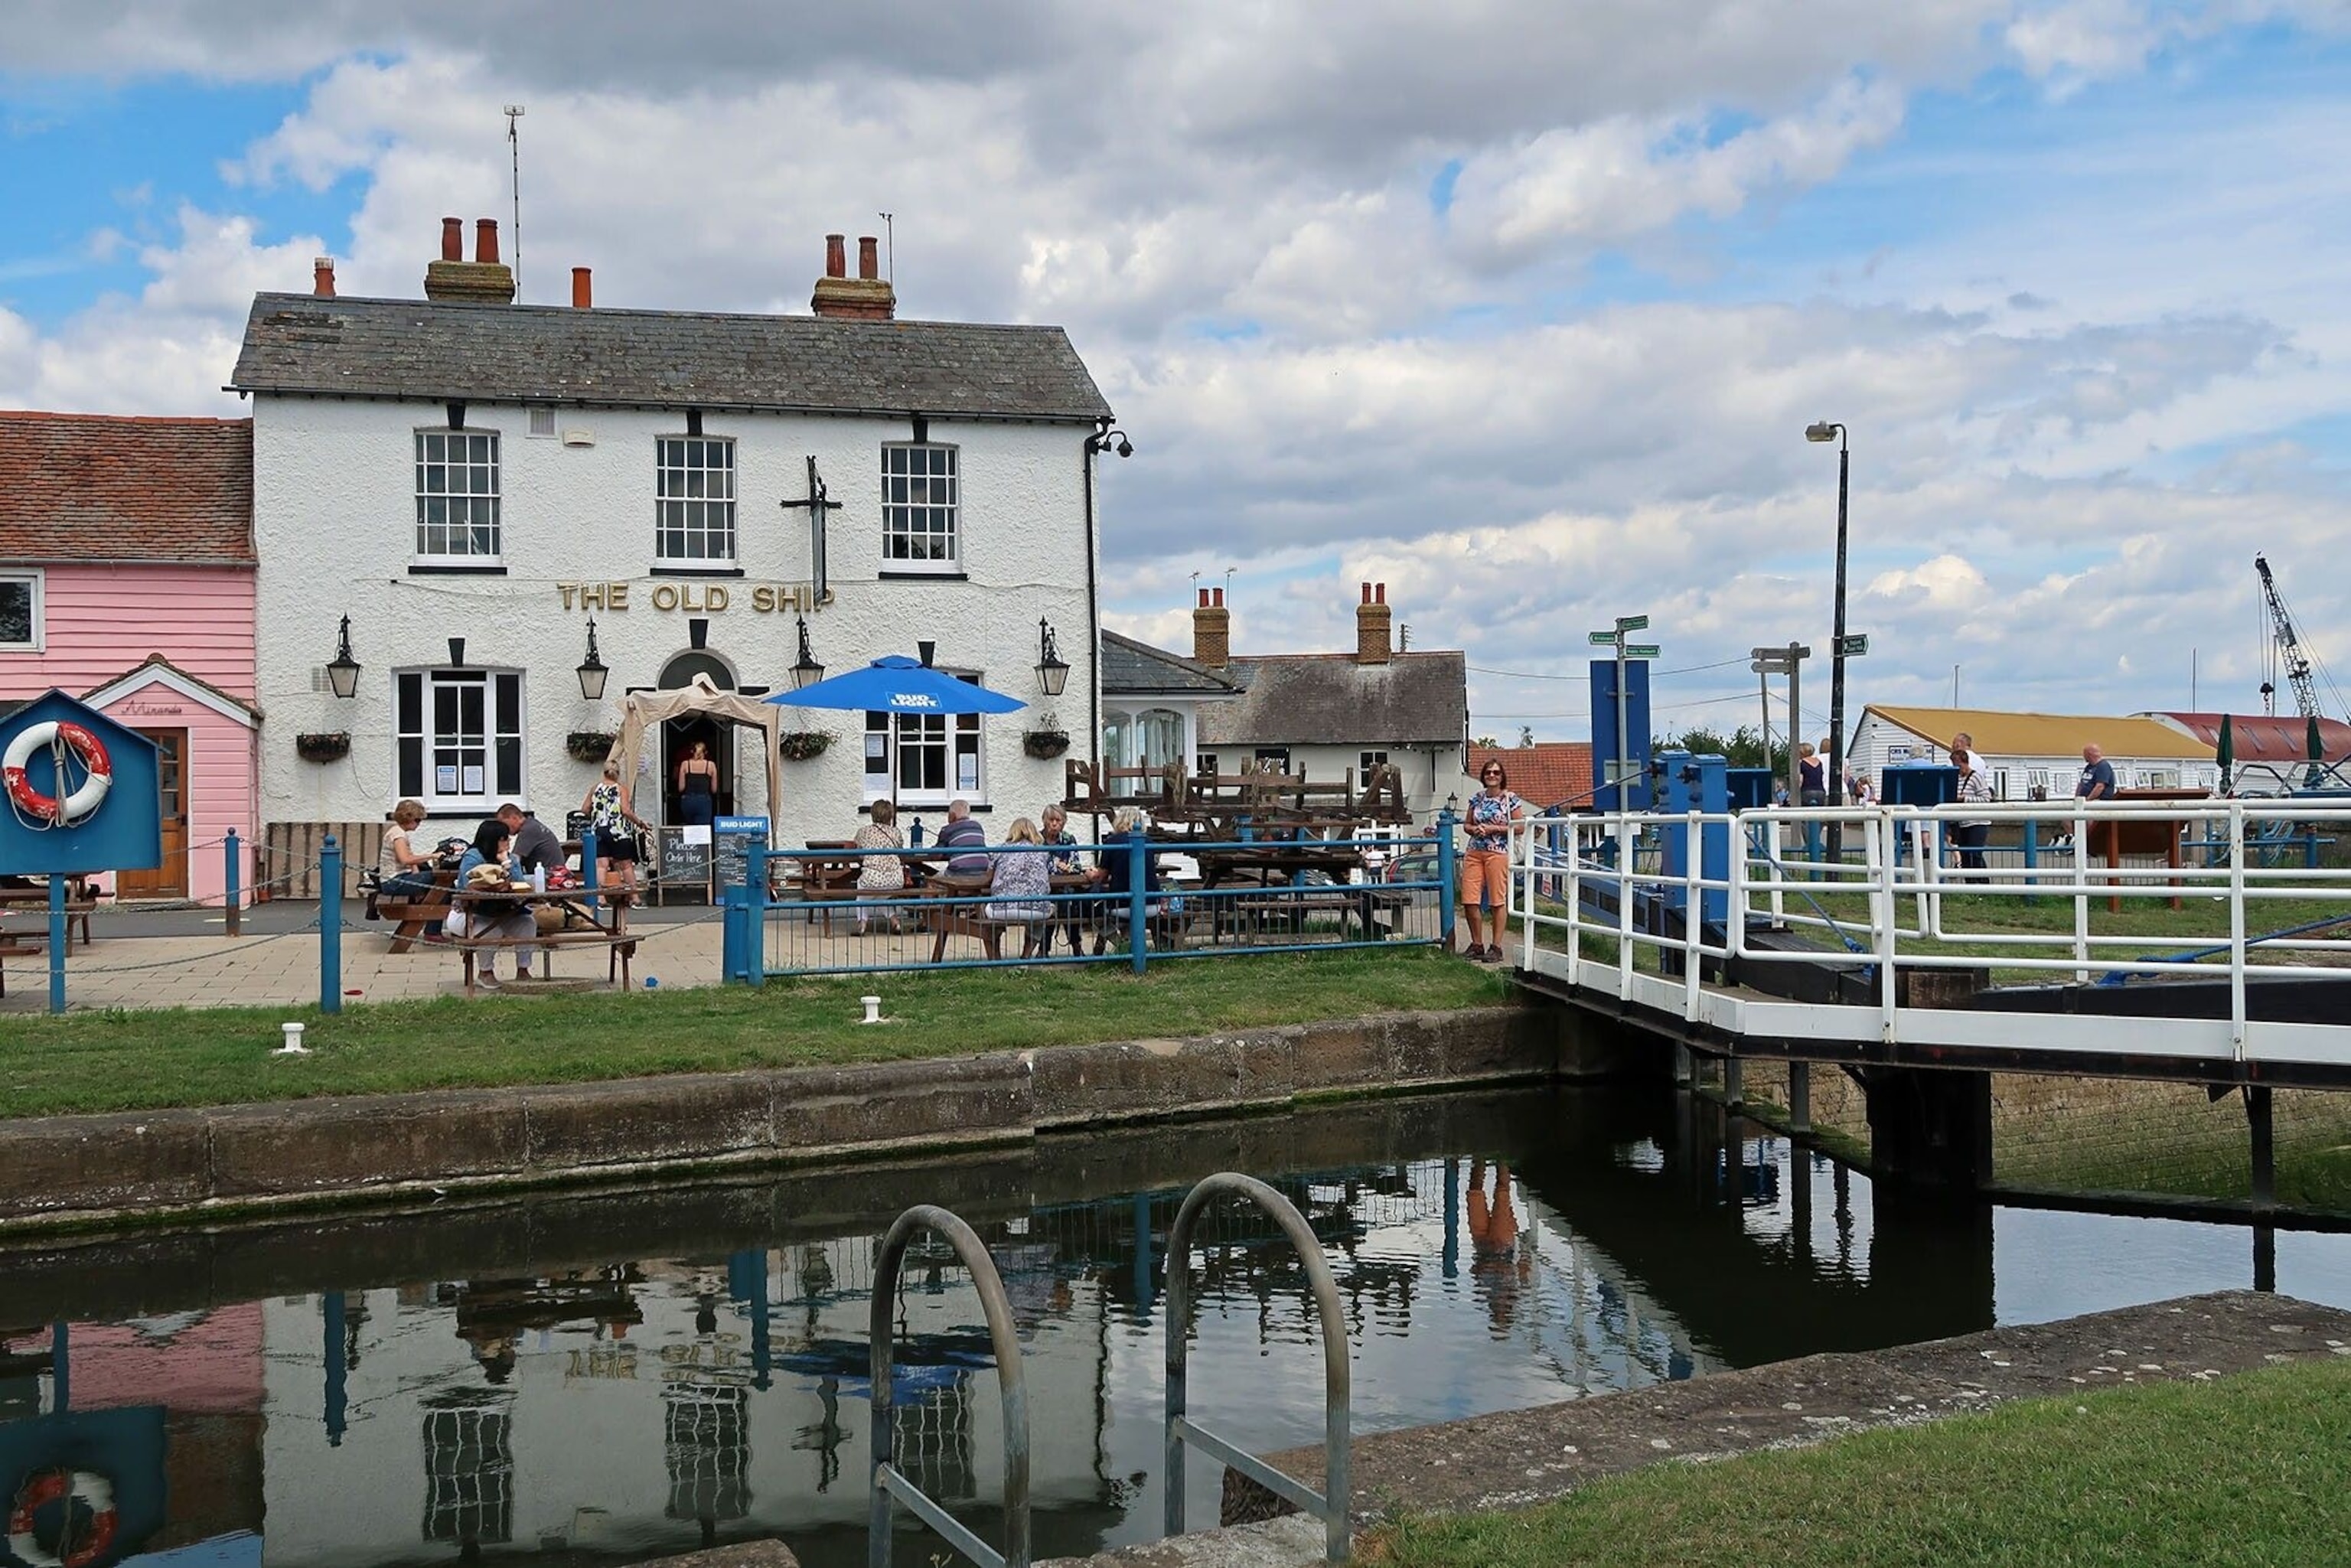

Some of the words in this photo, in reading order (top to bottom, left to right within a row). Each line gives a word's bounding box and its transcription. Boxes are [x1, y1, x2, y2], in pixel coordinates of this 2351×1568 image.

[557, 582, 629, 609] THE
[652, 584, 729, 611] OLD
[890, 699, 937, 707] LIGHT
